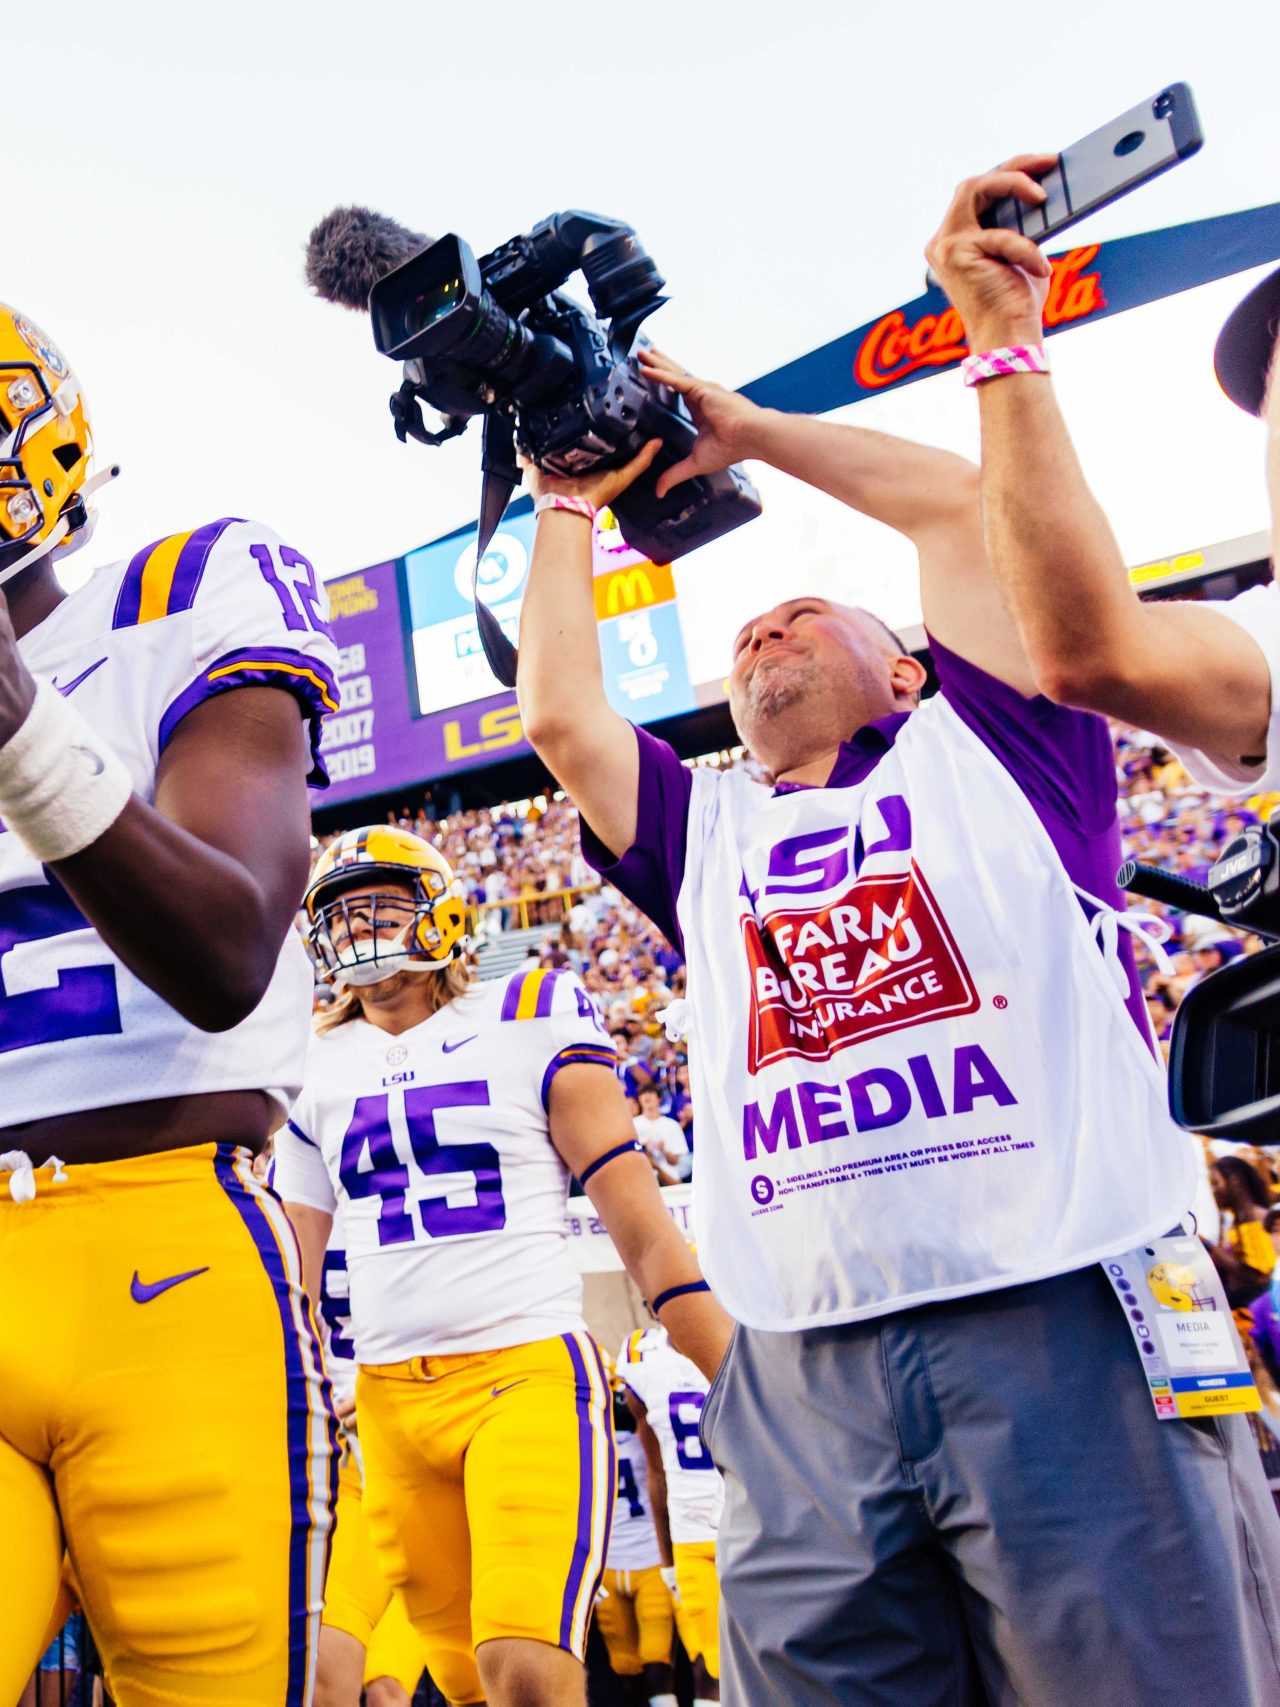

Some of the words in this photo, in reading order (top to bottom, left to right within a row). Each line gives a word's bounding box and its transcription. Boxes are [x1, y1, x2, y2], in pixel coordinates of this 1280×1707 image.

[853, 243, 1108, 389] Cocala
[249, 543, 338, 649] 12
[442, 705, 522, 762] LS
[1220, 854, 1248, 879] JVC
[755, 916, 923, 1011] BUREAU
[773, 896, 908, 964] FARM
[788, 970, 944, 1040] INURANCE
[381, 1070, 415, 1088] LSU
[742, 1042, 1019, 1161] MEDIA
[338, 1079, 507, 1247] 45
[828, 1166, 842, 1175] NO
[842, 1156, 883, 1172] PREMIUM
[884, 1151, 909, 1163] AREA
[910, 1149, 924, 1159] OR
[924, 1143, 955, 1155] PRESS
[955, 1140, 976, 1151] BOX
[976, 1133, 1012, 1146] ACCESS
[863, 1167, 884, 1178] THIS
[884, 1162, 908, 1173] VEST
[909, 1157, 936, 1168] MUST
[937, 1155, 950, 1163] BE
[950, 1150, 980, 1162] WORN
[980, 1148, 991, 1156] AT
[993, 1145, 1010, 1154] ALL
[1010, 1140, 1036, 1151] TIMES
[1176, 1321, 1211, 1333] MEDIA
